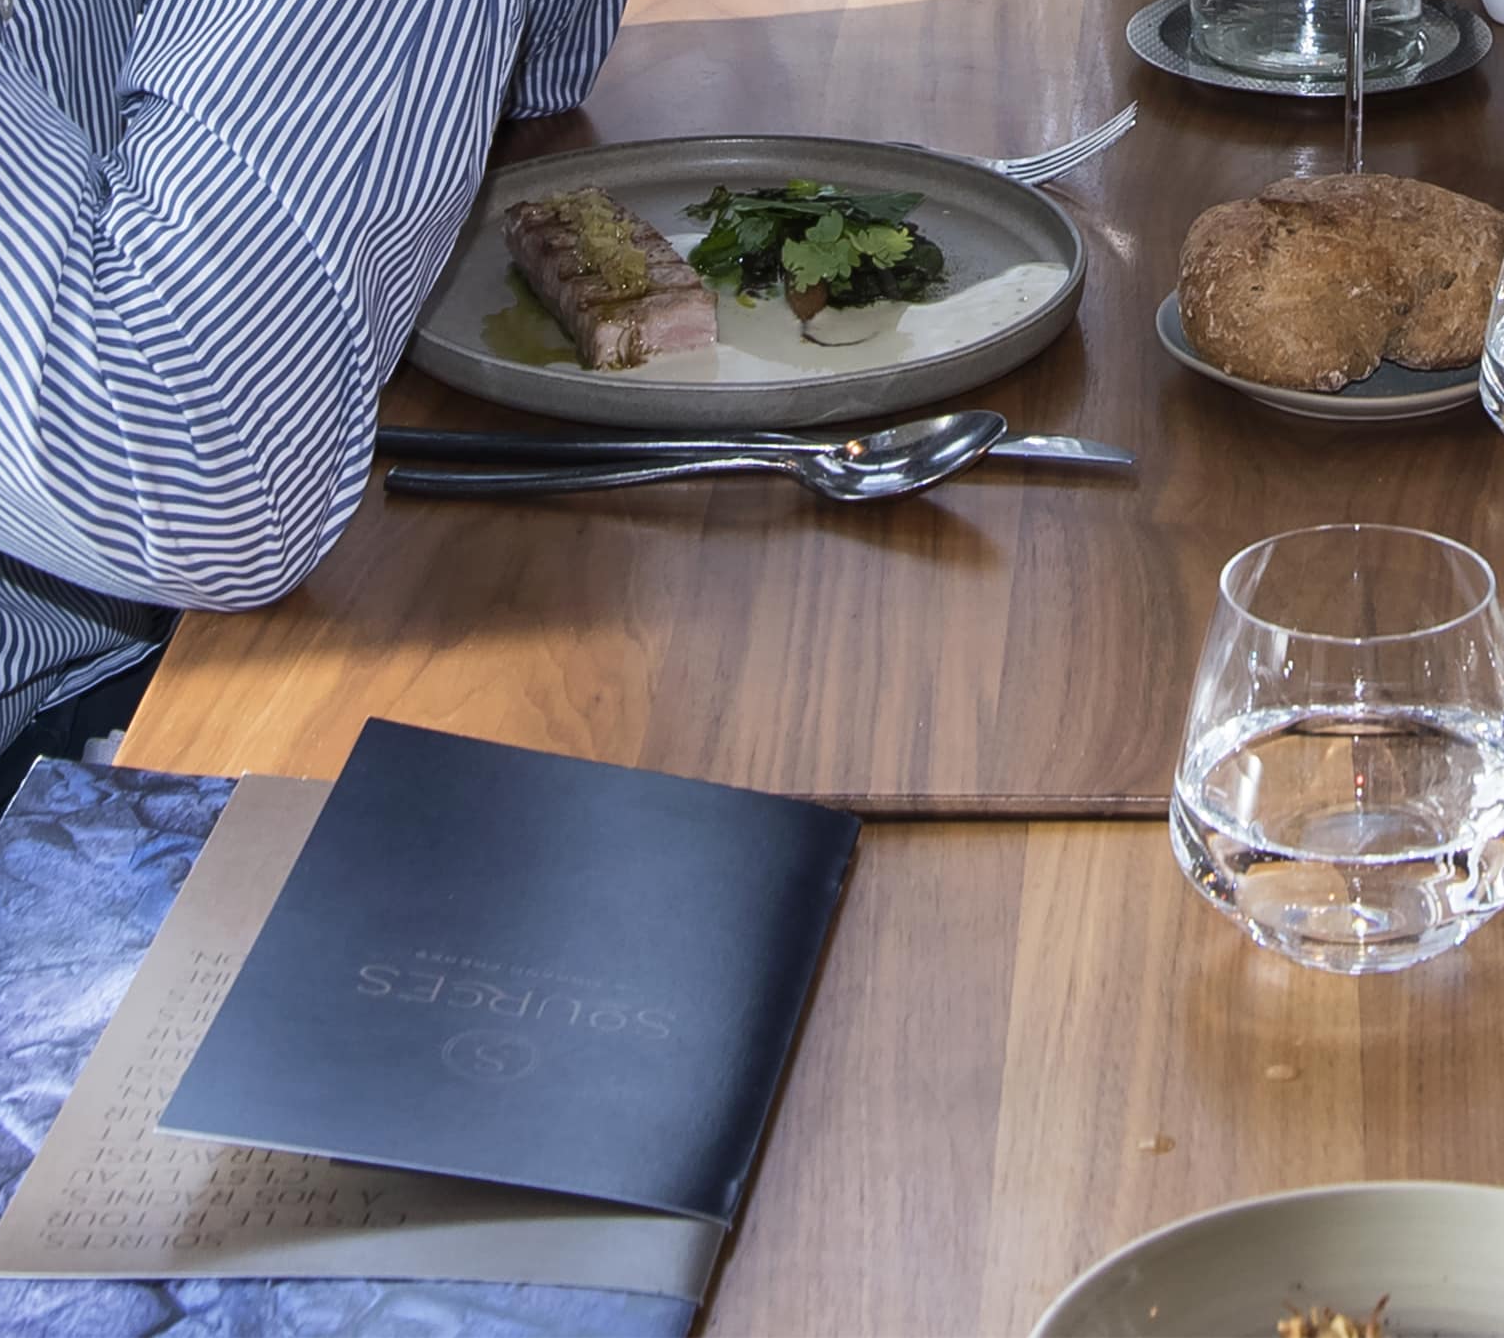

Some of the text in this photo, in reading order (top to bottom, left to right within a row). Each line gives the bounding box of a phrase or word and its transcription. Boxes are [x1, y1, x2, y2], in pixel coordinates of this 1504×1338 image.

[356, 963, 677, 1041] SOURCES
[254, 1187, 339, 1207] NOS
[45, 1210, 208, 1229] RETOUR
